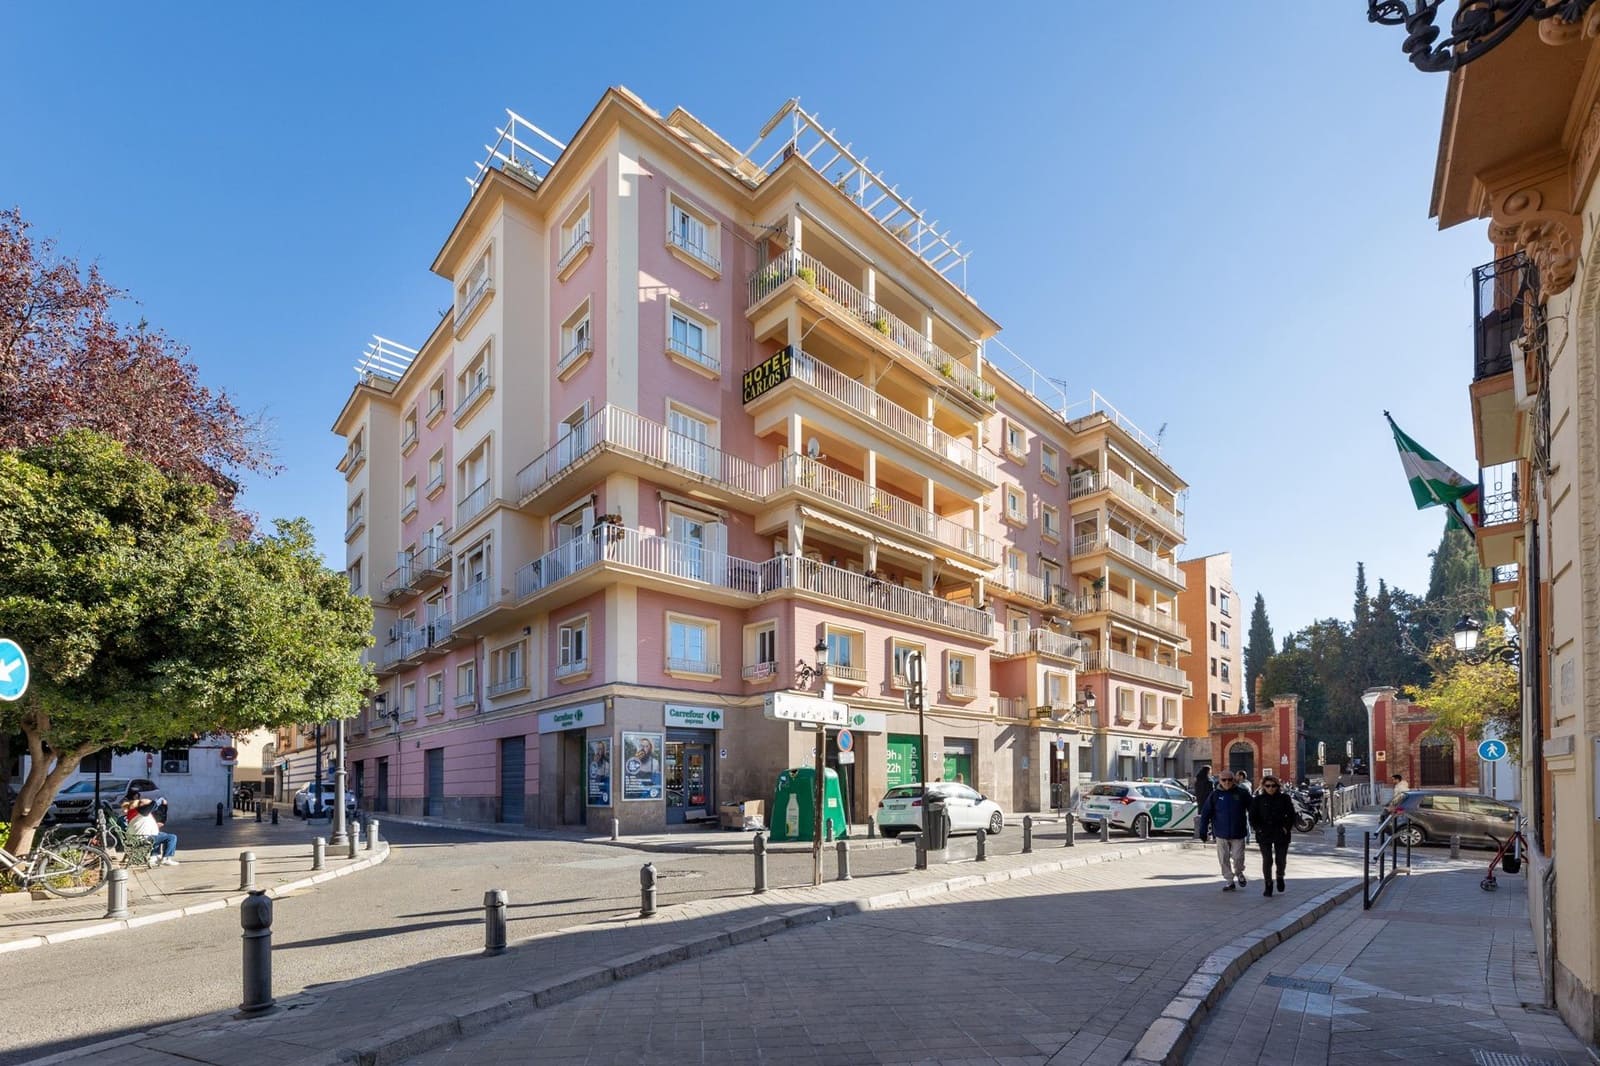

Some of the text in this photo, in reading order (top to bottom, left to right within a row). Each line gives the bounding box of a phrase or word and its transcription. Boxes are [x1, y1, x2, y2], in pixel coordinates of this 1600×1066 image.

[744, 351, 790, 389] HOTEL
[744, 363, 790, 402] CARLOS V
[669, 708, 704, 719] Carrefour
